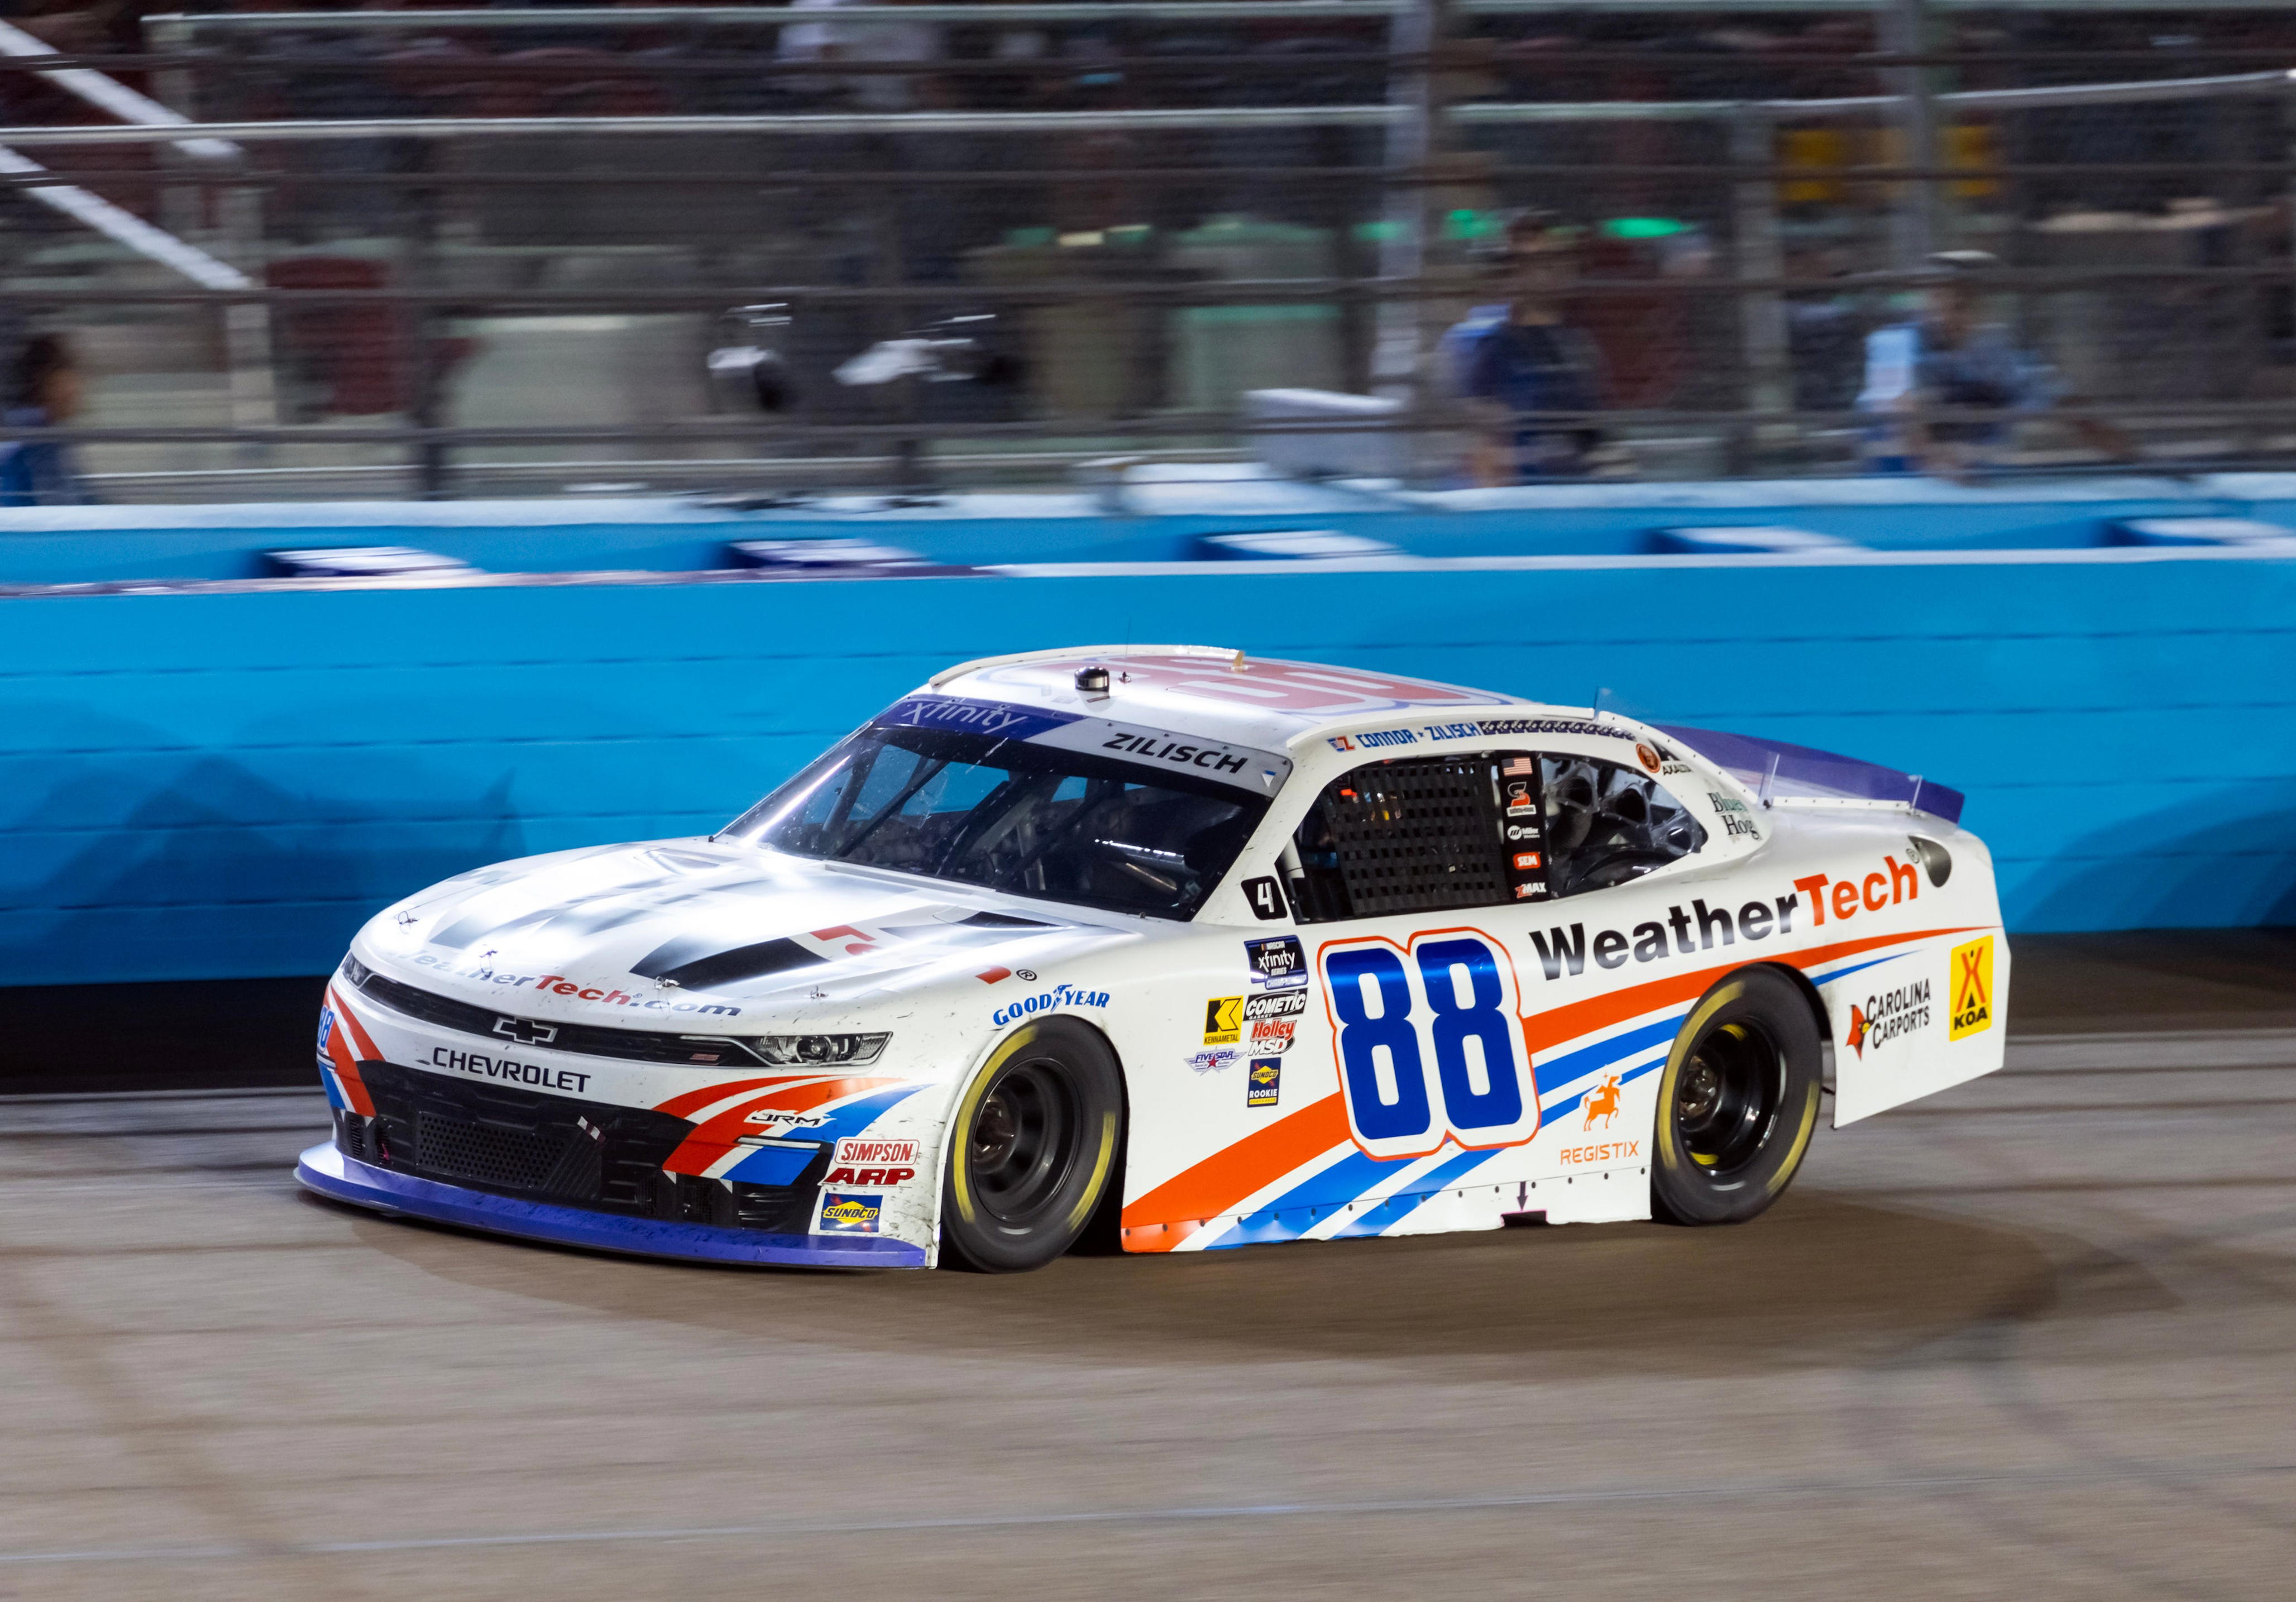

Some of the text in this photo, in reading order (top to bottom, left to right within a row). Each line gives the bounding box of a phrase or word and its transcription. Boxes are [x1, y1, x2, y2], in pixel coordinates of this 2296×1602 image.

[901, 699, 1029, 734] xfinity
[1355, 723, 1482, 748] CONNOR ZILISCH
[1102, 733, 1249, 774] ZILISCH
[1721, 814, 1761, 840] Hog
[1257, 882, 1275, 913] 4
[1529, 856, 1919, 981] WeatherTech
[1257, 950, 1295, 973] xfinity
[993, 984, 1110, 1026] GOODYEAR
[1245, 993, 1307, 1016] COMETIC
[1866, 978, 1931, 1026] CAROLINA
[1251, 1018, 1296, 1041] Holley
[1872, 1006, 1930, 1049] CARPORTS
[1954, 1007, 1988, 1031] KOA
[1203, 1034, 1239, 1045] KENNAMETAL
[1249, 1040, 1288, 1056] MSD
[1326, 938, 1523, 1140] 88
[1195, 1051, 1233, 1063] FIVE STAR
[433, 1047, 591, 1093] CHEVROLET
[1252, 1070, 1279, 1079] SUNOCO
[1249, 1089, 1278, 1099] ROOKIE
[751, 1114, 822, 1127] JRM
[841, 1142, 913, 1162] SIMPSON
[1560, 1140, 1639, 1165] REGISTIX
[822, 1168, 915, 1185] ARP
[825, 1208, 877, 1218] SUNOCO
